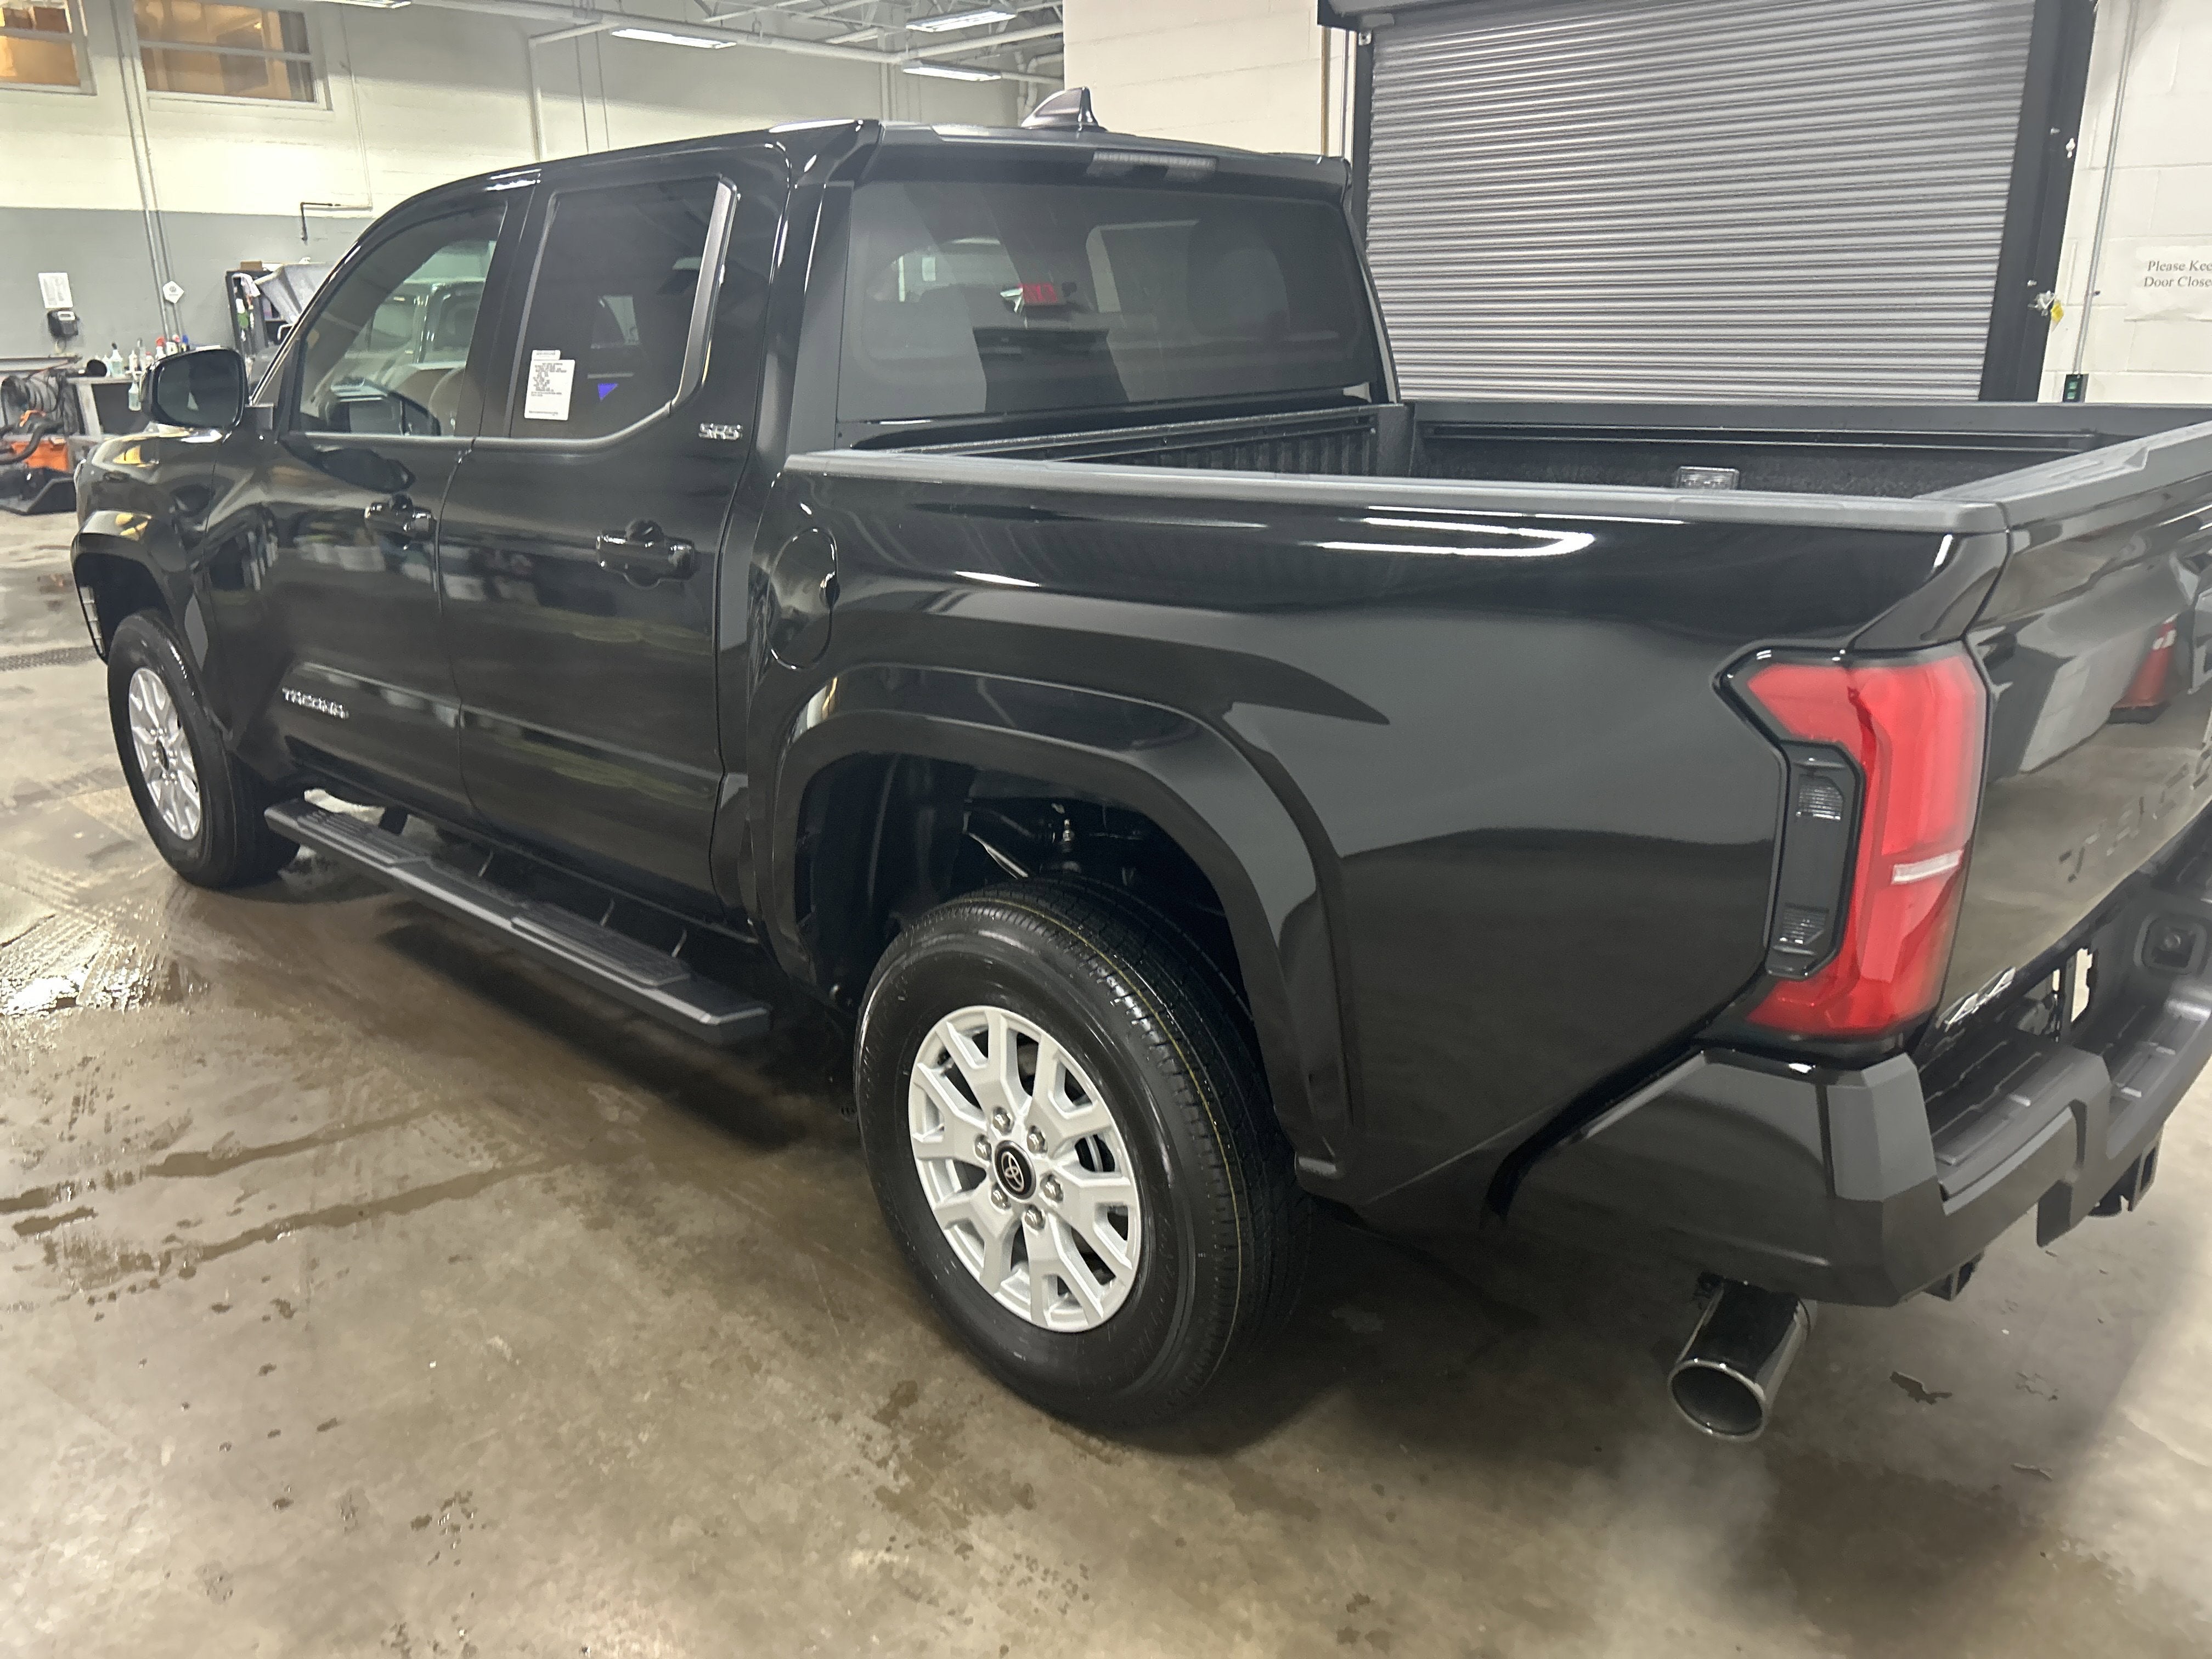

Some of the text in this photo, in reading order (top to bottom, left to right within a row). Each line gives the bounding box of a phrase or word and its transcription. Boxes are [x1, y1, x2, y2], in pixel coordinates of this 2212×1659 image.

[2147, 260, 2186, 272] Please
[2143, 276, 2174, 287] Door
[698, 423, 743, 441] SR5
[282, 687, 349, 719] TACOMA
